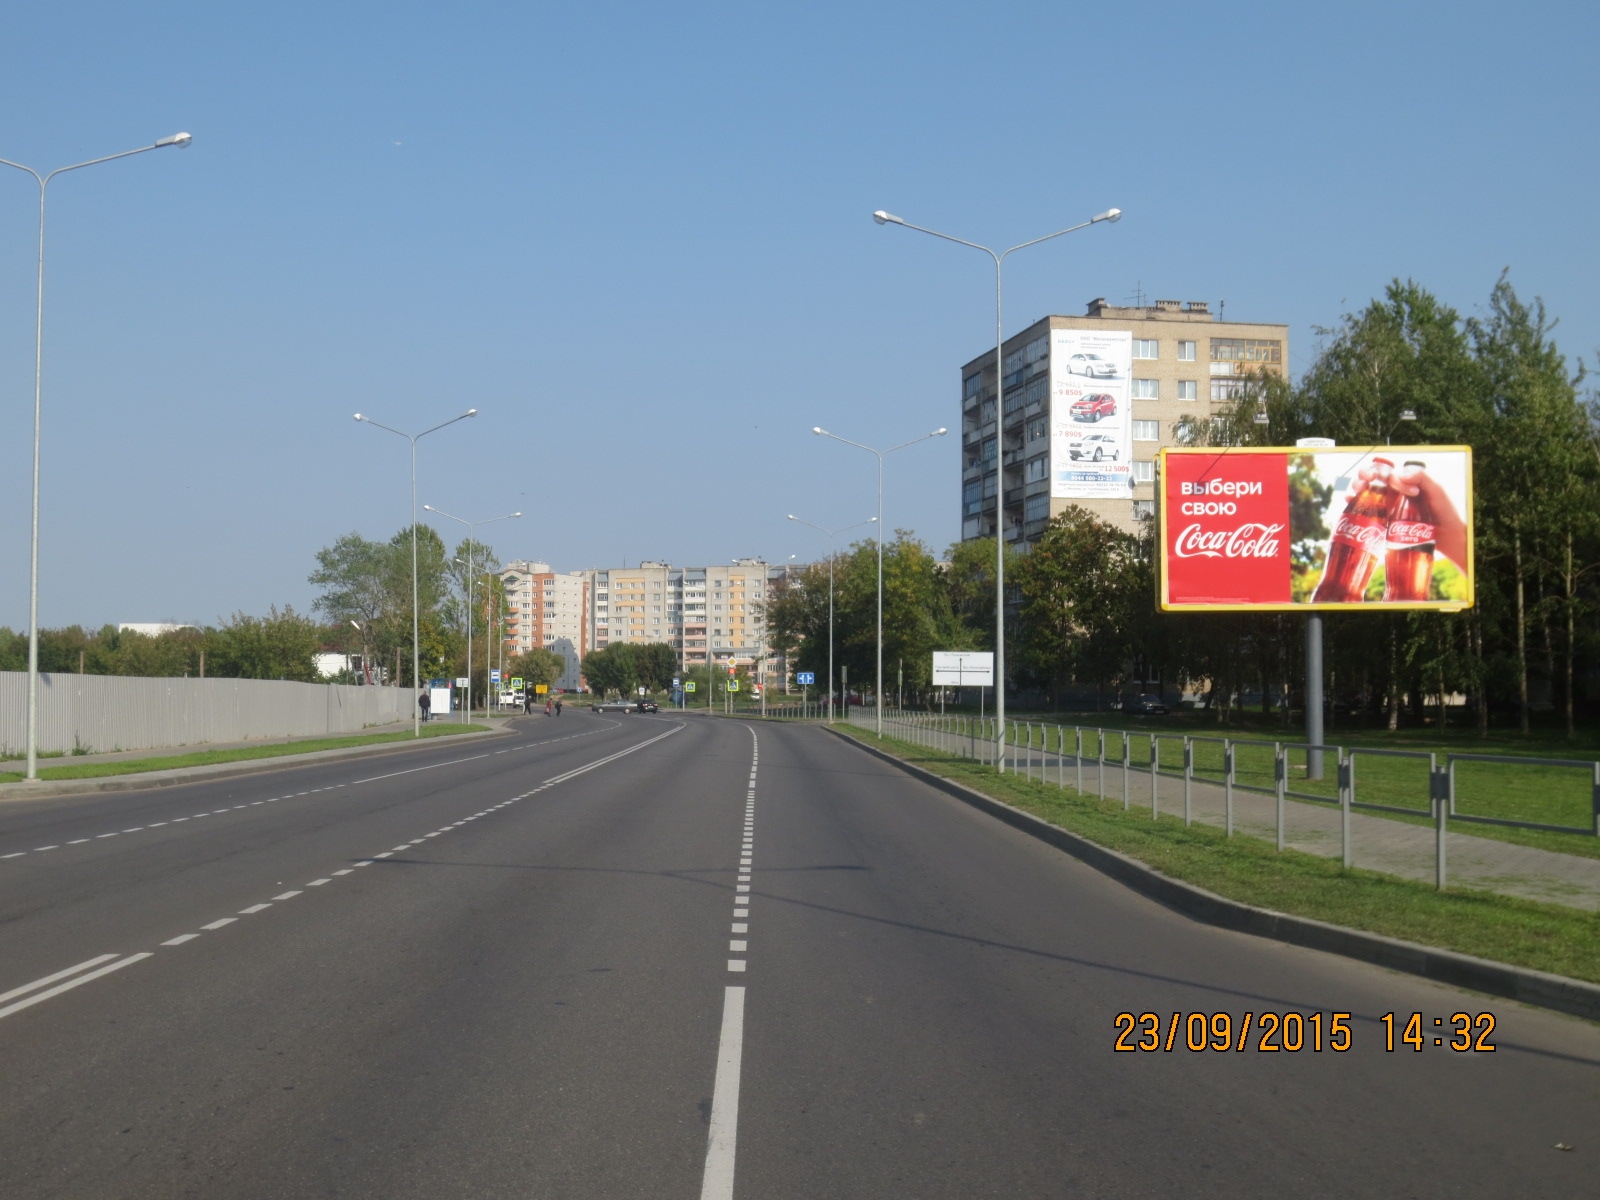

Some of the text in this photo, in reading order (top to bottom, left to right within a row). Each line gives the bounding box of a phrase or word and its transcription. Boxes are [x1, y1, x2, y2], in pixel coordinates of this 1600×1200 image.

[1065, 389, 1083, 397] 850$
[1181, 477, 1262, 498] выбери
[1181, 502, 1237, 516] свою
[1389, 521, 1434, 539] Coca-Cola
[1175, 523, 1286, 558] Coca-Cola
